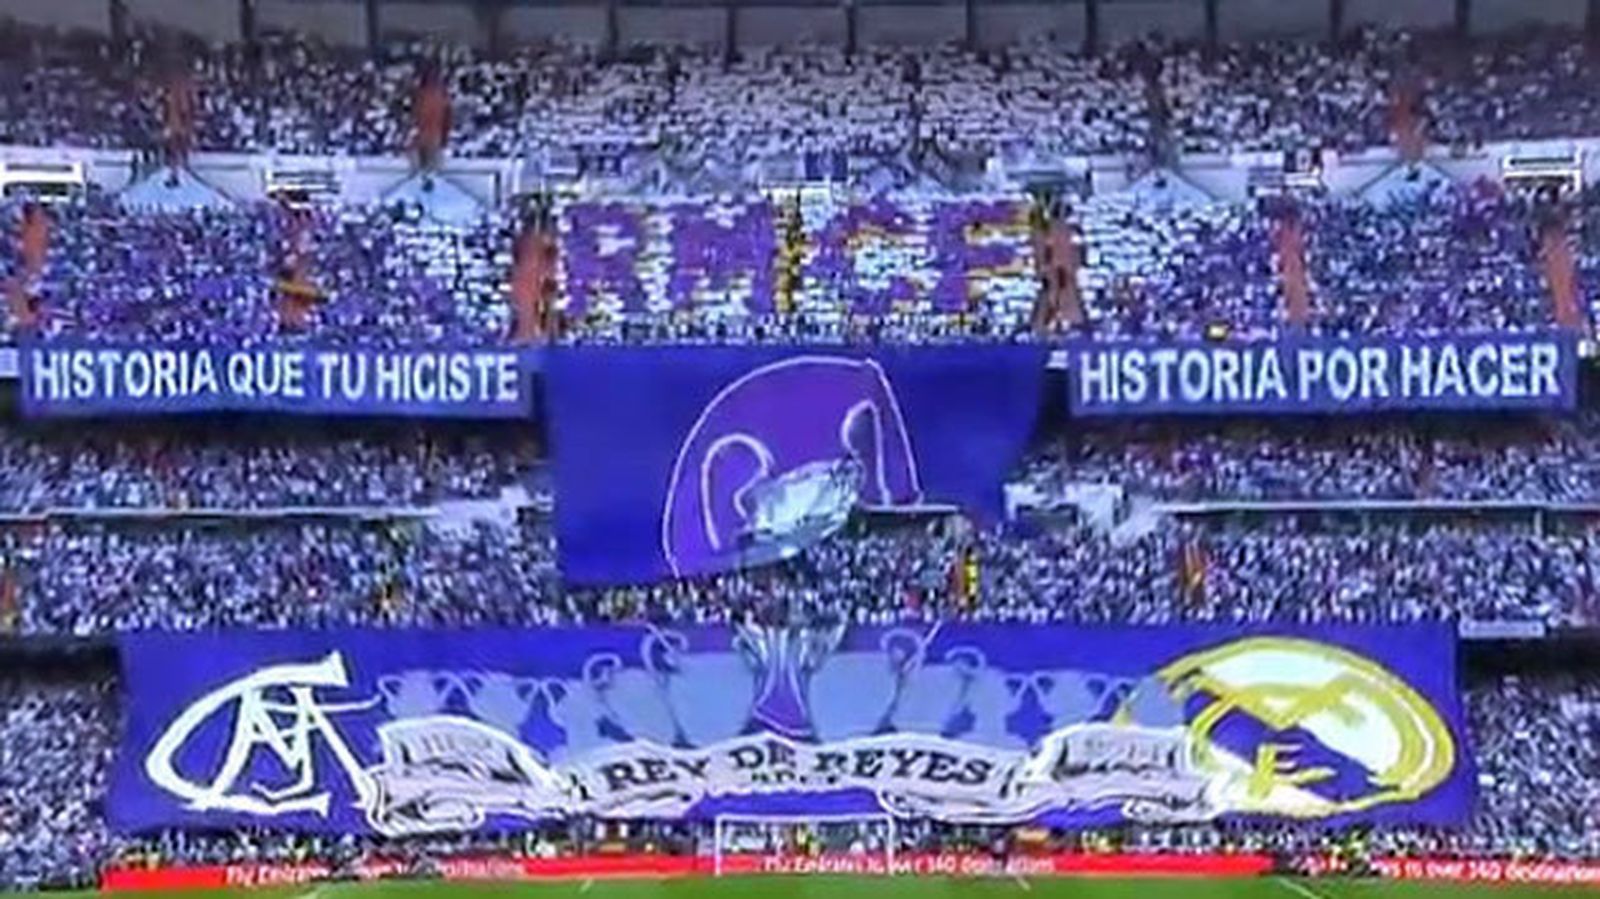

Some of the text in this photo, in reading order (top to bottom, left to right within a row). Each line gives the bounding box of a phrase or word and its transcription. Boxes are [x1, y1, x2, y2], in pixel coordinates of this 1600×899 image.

[33, 349, 519, 402] HISTORIA QUE TU HICISTE
[1080, 343, 1561, 402] HISTORIA POR HACER
[606, 756, 711, 792] REY
